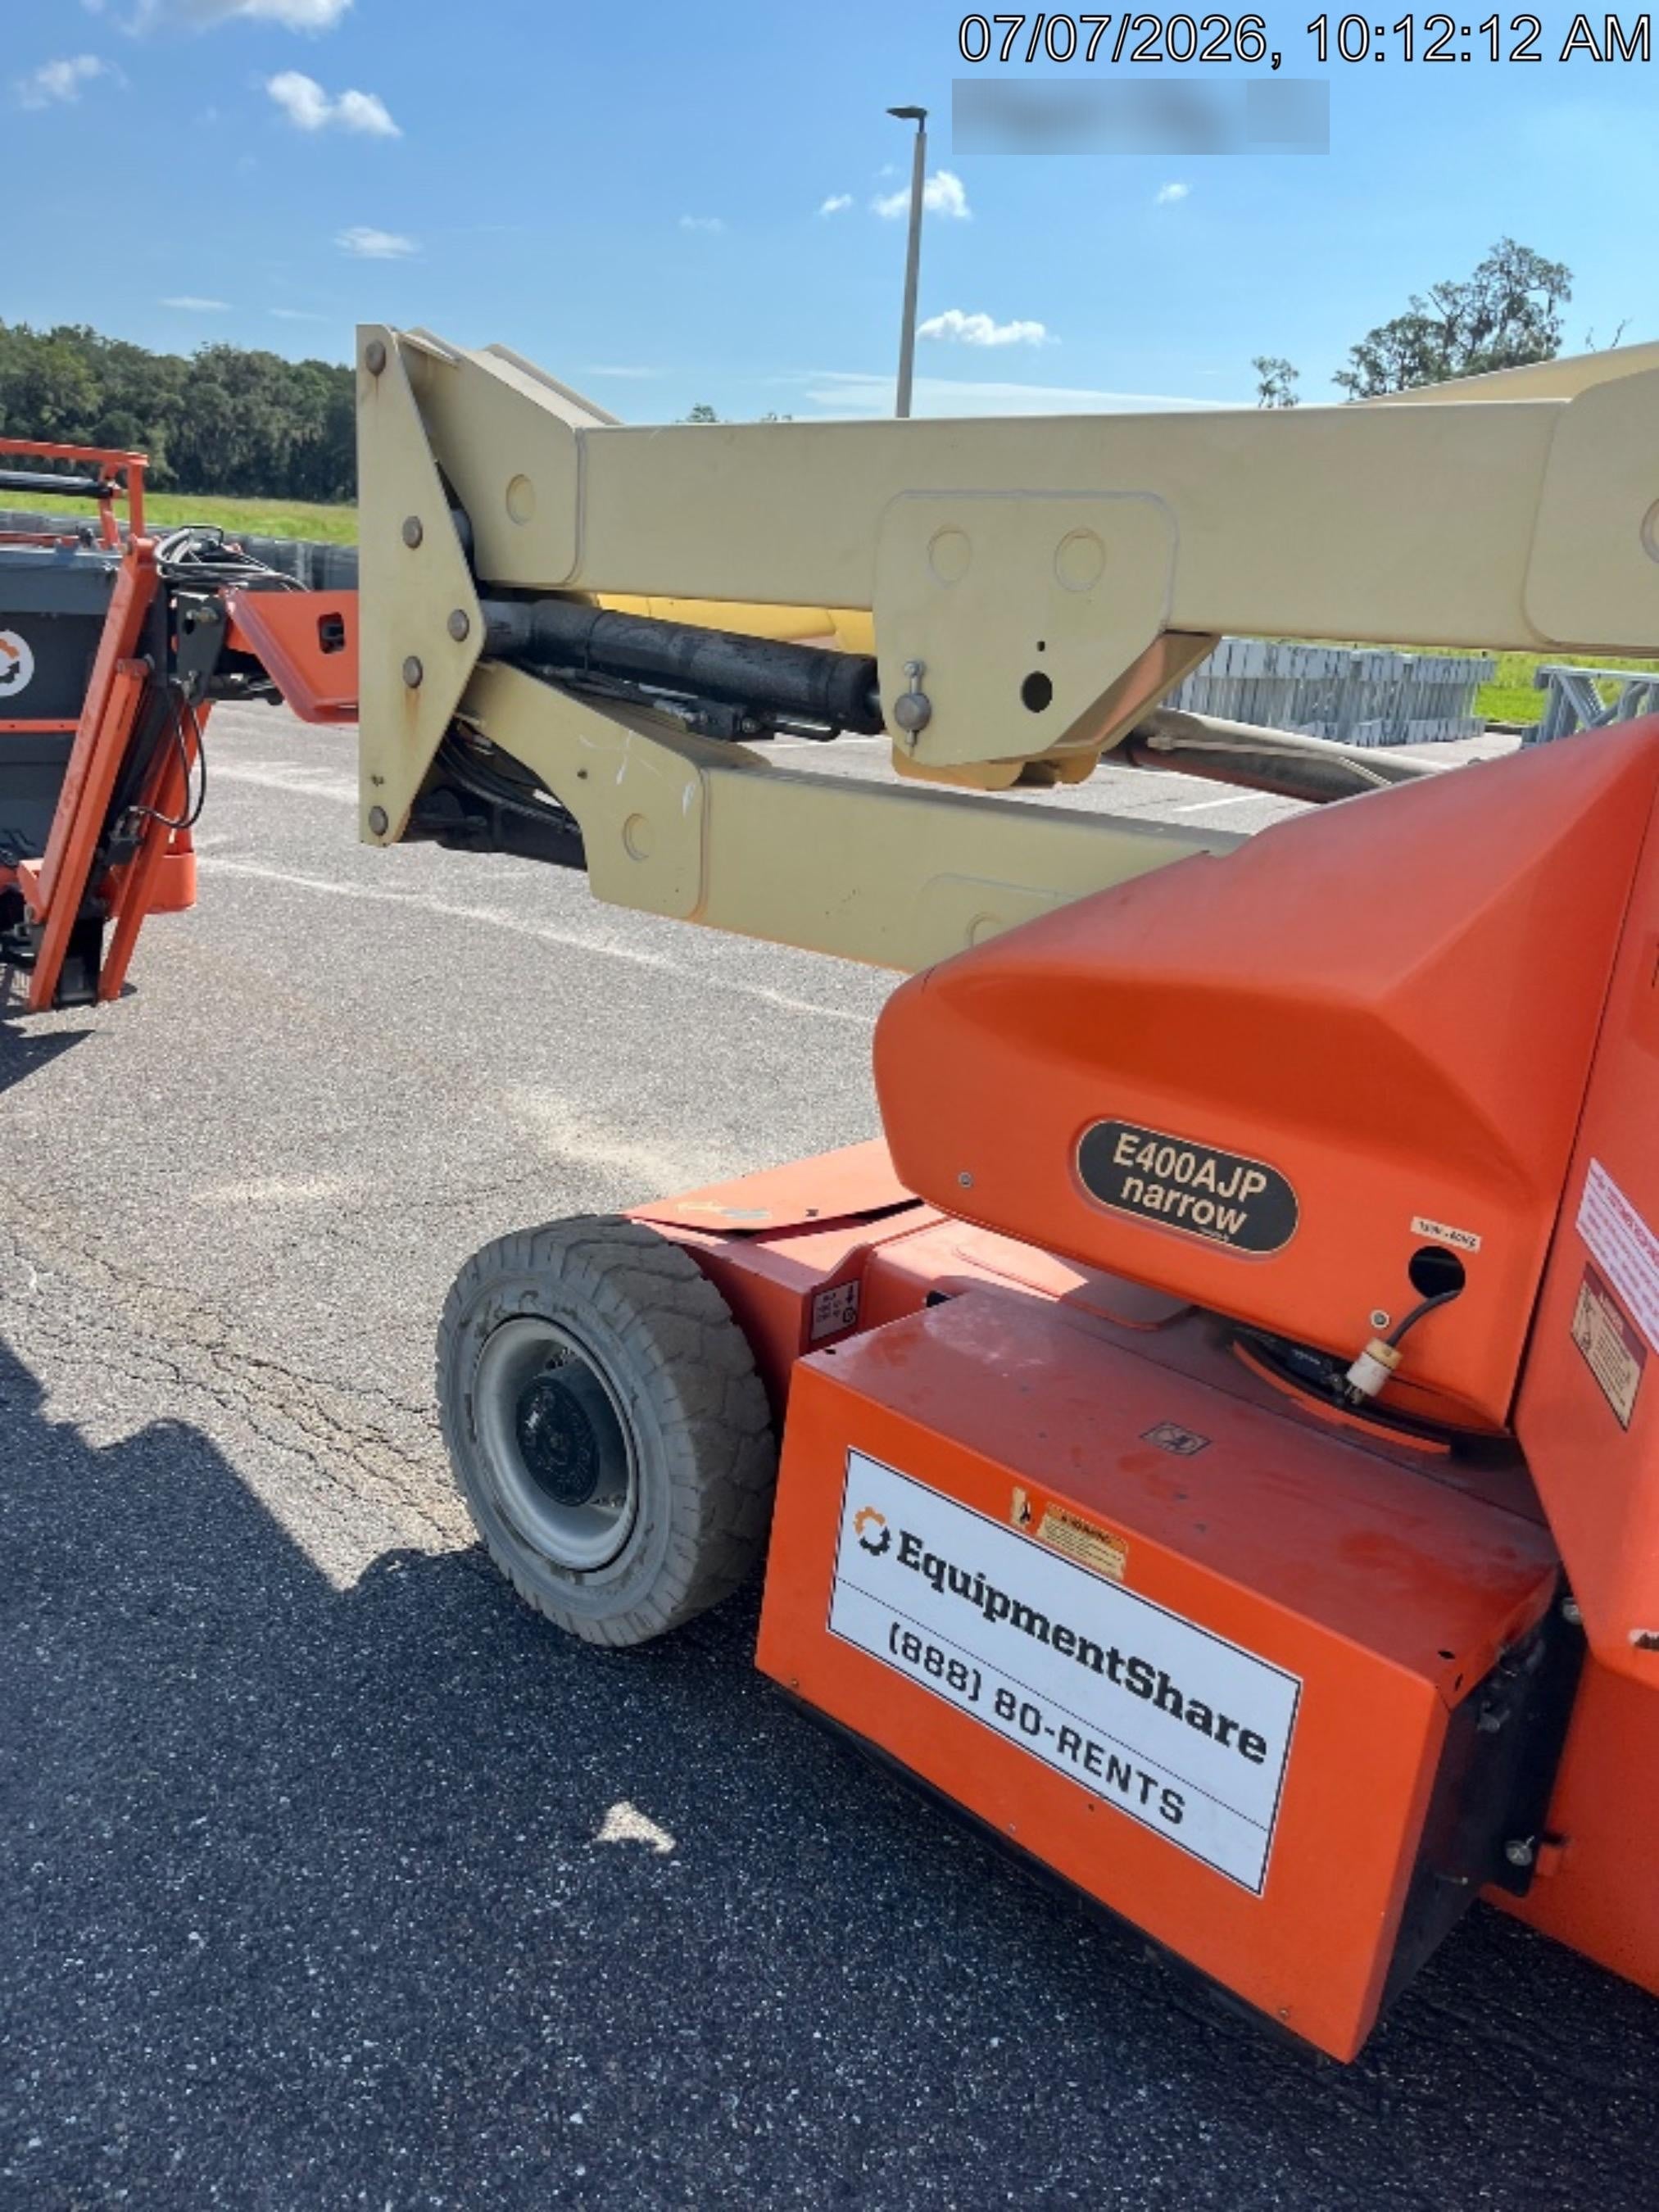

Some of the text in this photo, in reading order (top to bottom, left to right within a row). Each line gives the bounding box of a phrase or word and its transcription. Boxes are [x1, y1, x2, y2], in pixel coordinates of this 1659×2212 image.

[1113, 1132, 1267, 1202] E400AJP
[1121, 1175, 1248, 1235] narrow
[896, 1529, 1268, 1764] EquipmentShare
[889, 1621, 1186, 1825] (888) 80-RENTS
